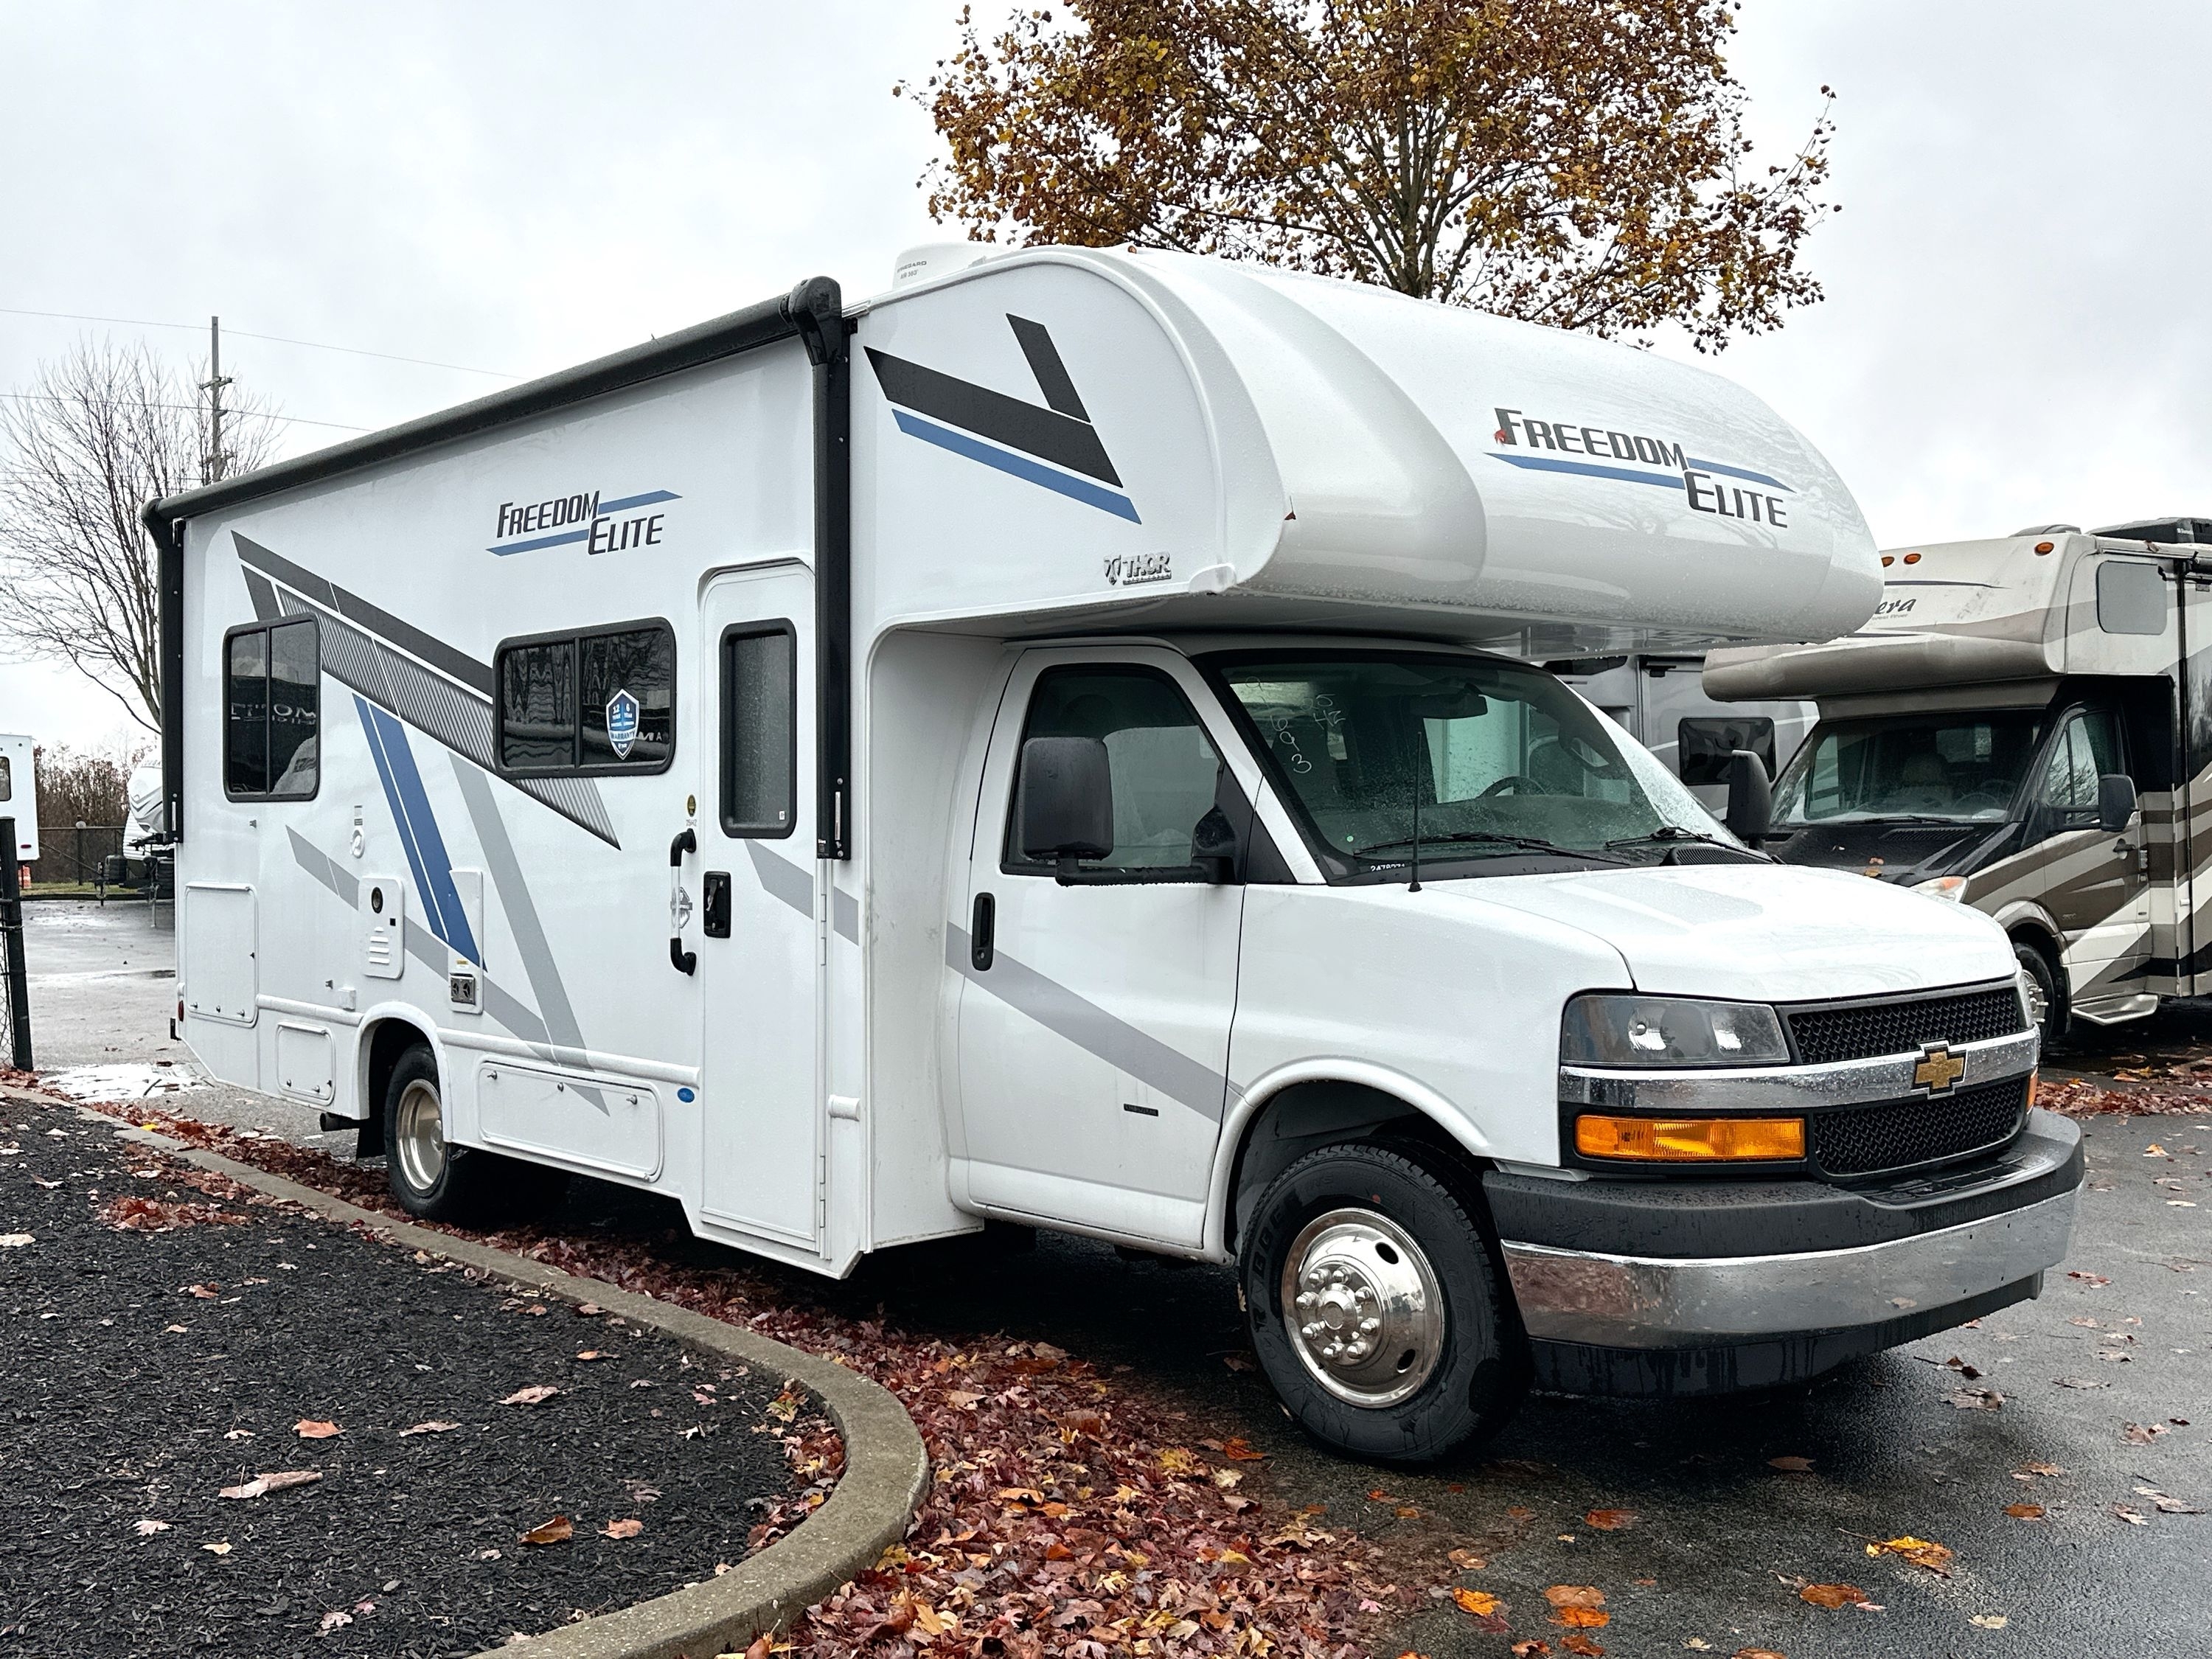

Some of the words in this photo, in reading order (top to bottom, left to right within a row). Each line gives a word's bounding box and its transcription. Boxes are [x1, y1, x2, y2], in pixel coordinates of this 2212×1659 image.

[1494, 407, 1688, 471] FREEDOM
[496, 490, 600, 538] FREEDOM
[1684, 470, 1789, 529] ELITE
[588, 513, 665, 555] ELITE
[1122, 552, 1171, 579] THOR
[1874, 598, 1917, 614] era
